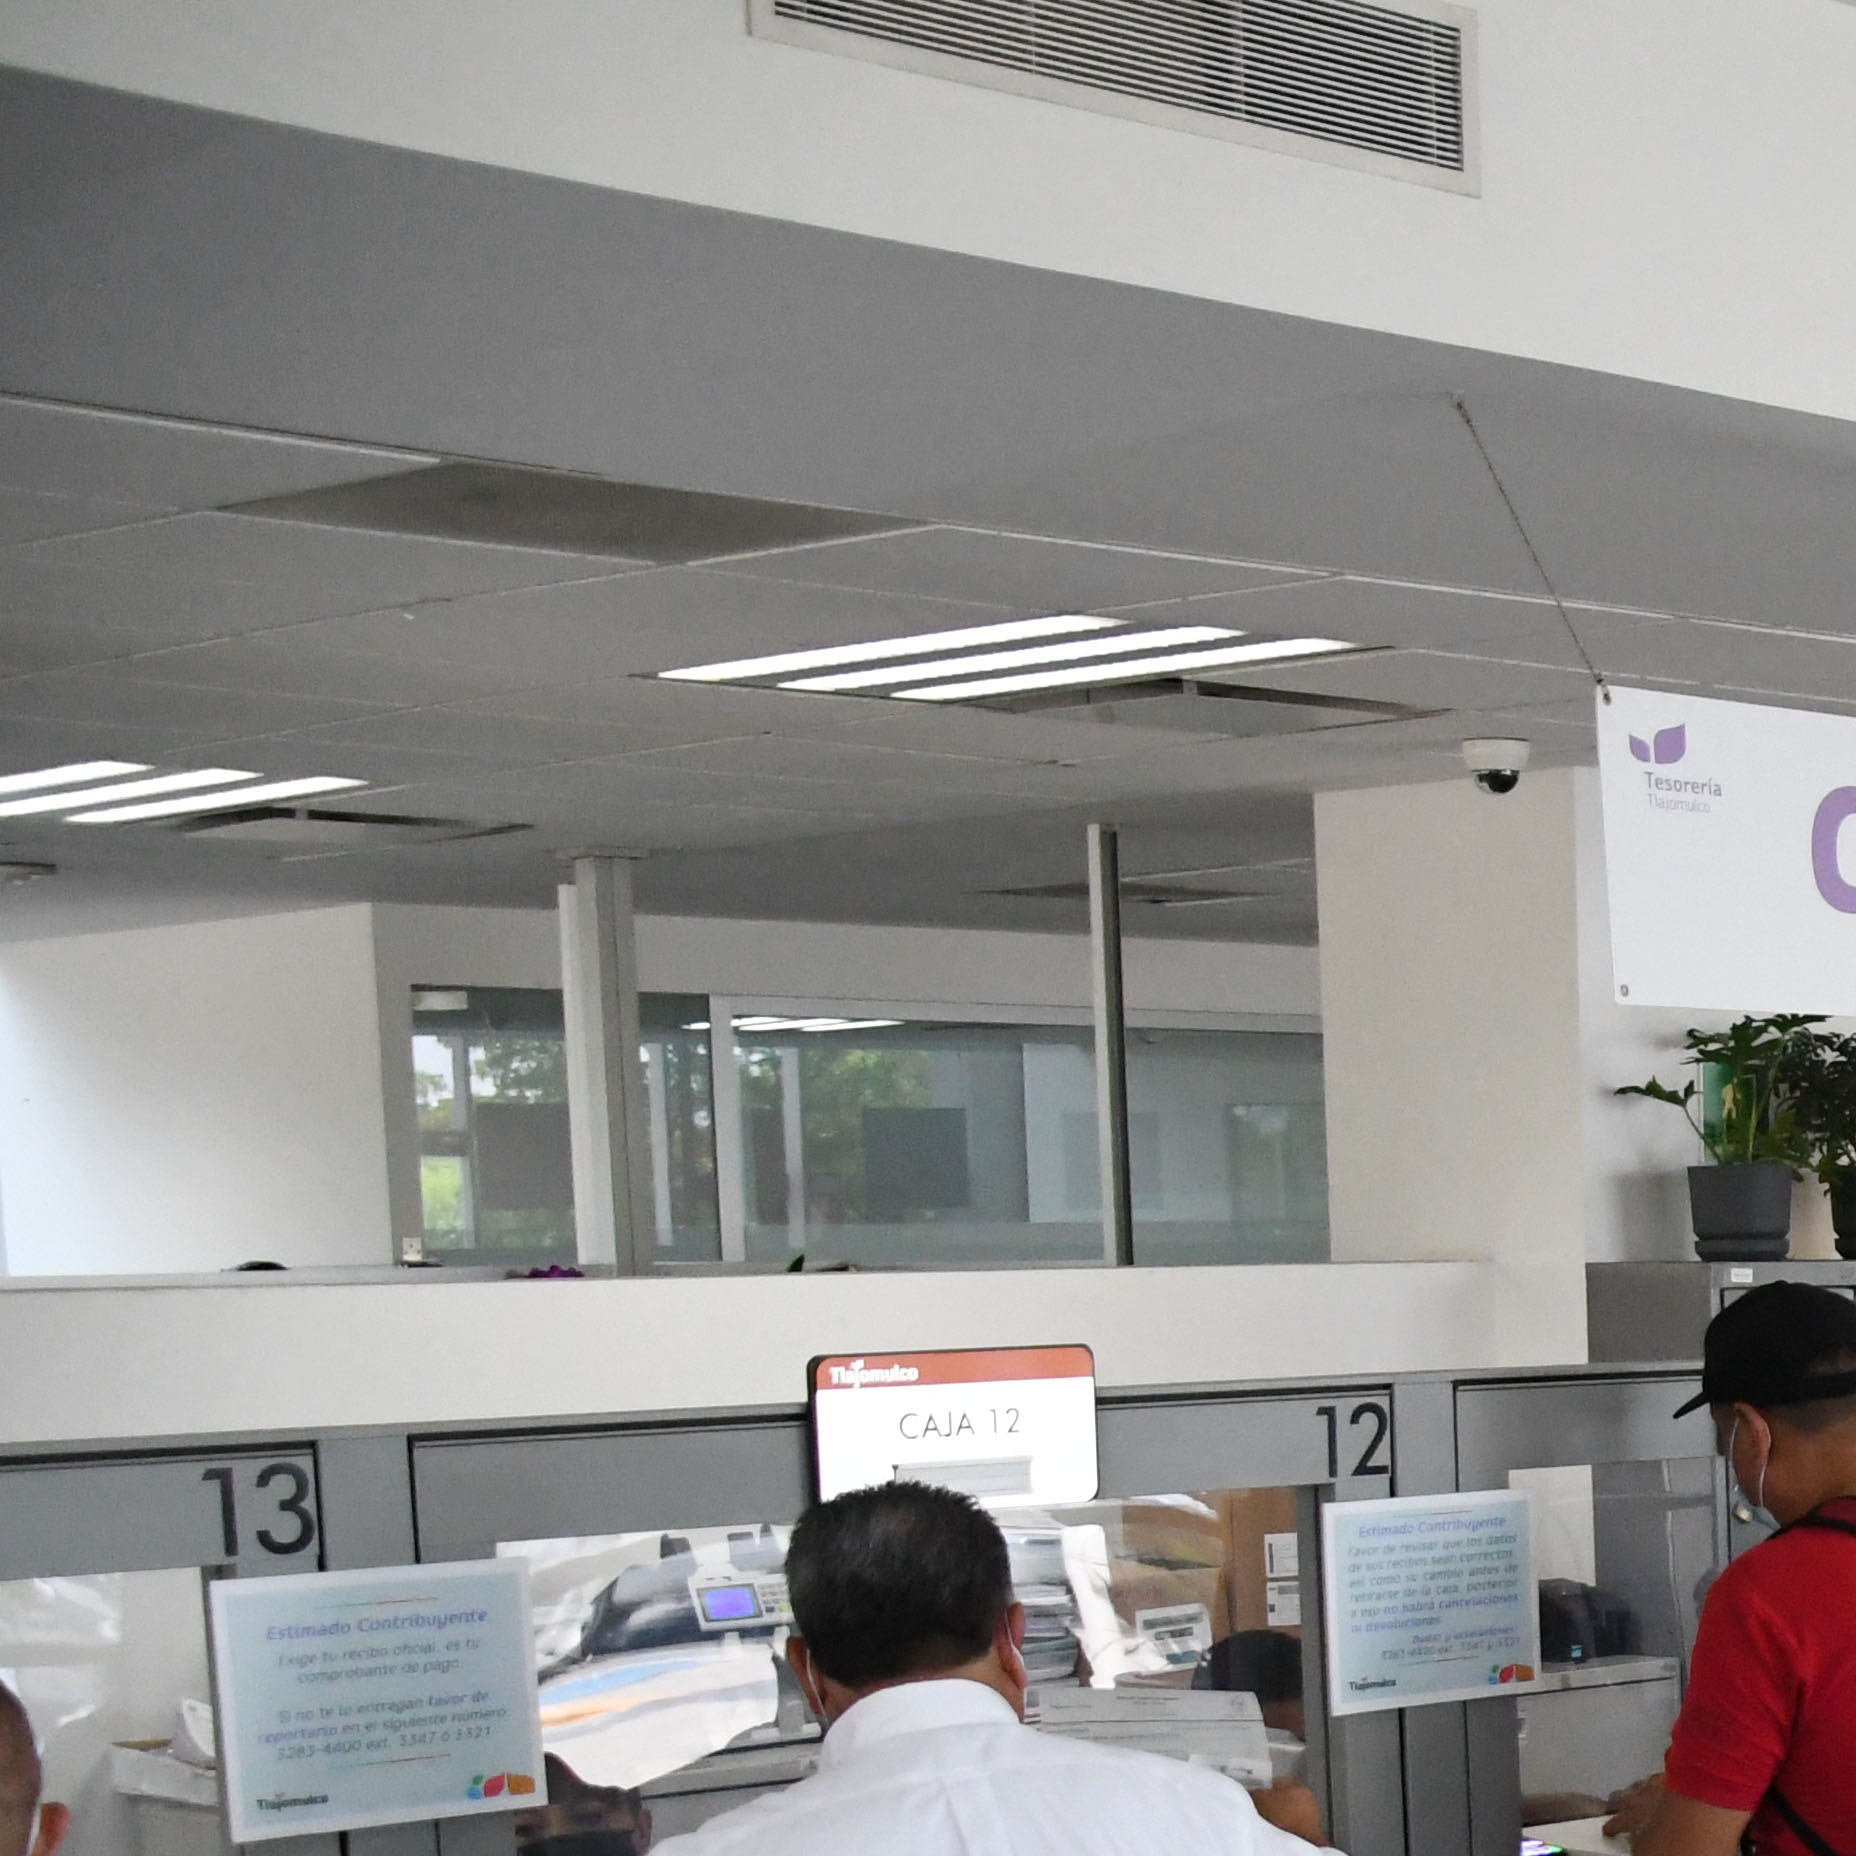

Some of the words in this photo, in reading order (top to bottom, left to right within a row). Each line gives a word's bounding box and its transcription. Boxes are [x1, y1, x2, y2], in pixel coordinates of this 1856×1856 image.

[1643, 771, 1723, 796] Tesorería
[1646, 793, 1711, 814] Tlajomulco
[829, 1359, 919, 1389] Tlajomulco
[900, 1411, 975, 1440] CAJA
[989, 1408, 1020, 1434] 12
[1316, 1402, 1389, 1478] 12
[201, 1462, 315, 1557] 13
[1358, 1522, 1414, 1538] Estimado
[1417, 1515, 1507, 1534] Contribuyente
[266, 1620, 352, 1641] Estimado
[356, 1607, 489, 1632] Contribuyente
[278, 1652, 318, 1669] Exige
[321, 1649, 339, 1663] tu
[343, 1644, 389, 1661] recibo
[445, 1640, 461, 1652] es
[297, 1660, 398, 1685] comprobante
[400, 1660, 419, 1675] de
[296, 1709, 314, 1722] no
[357, 1697, 425, 1717] entregan
[341, 1722, 361, 1736] en
[382, 1712, 448, 1733] siguiente
[256, 1791, 329, 1812] Tlajomulco
